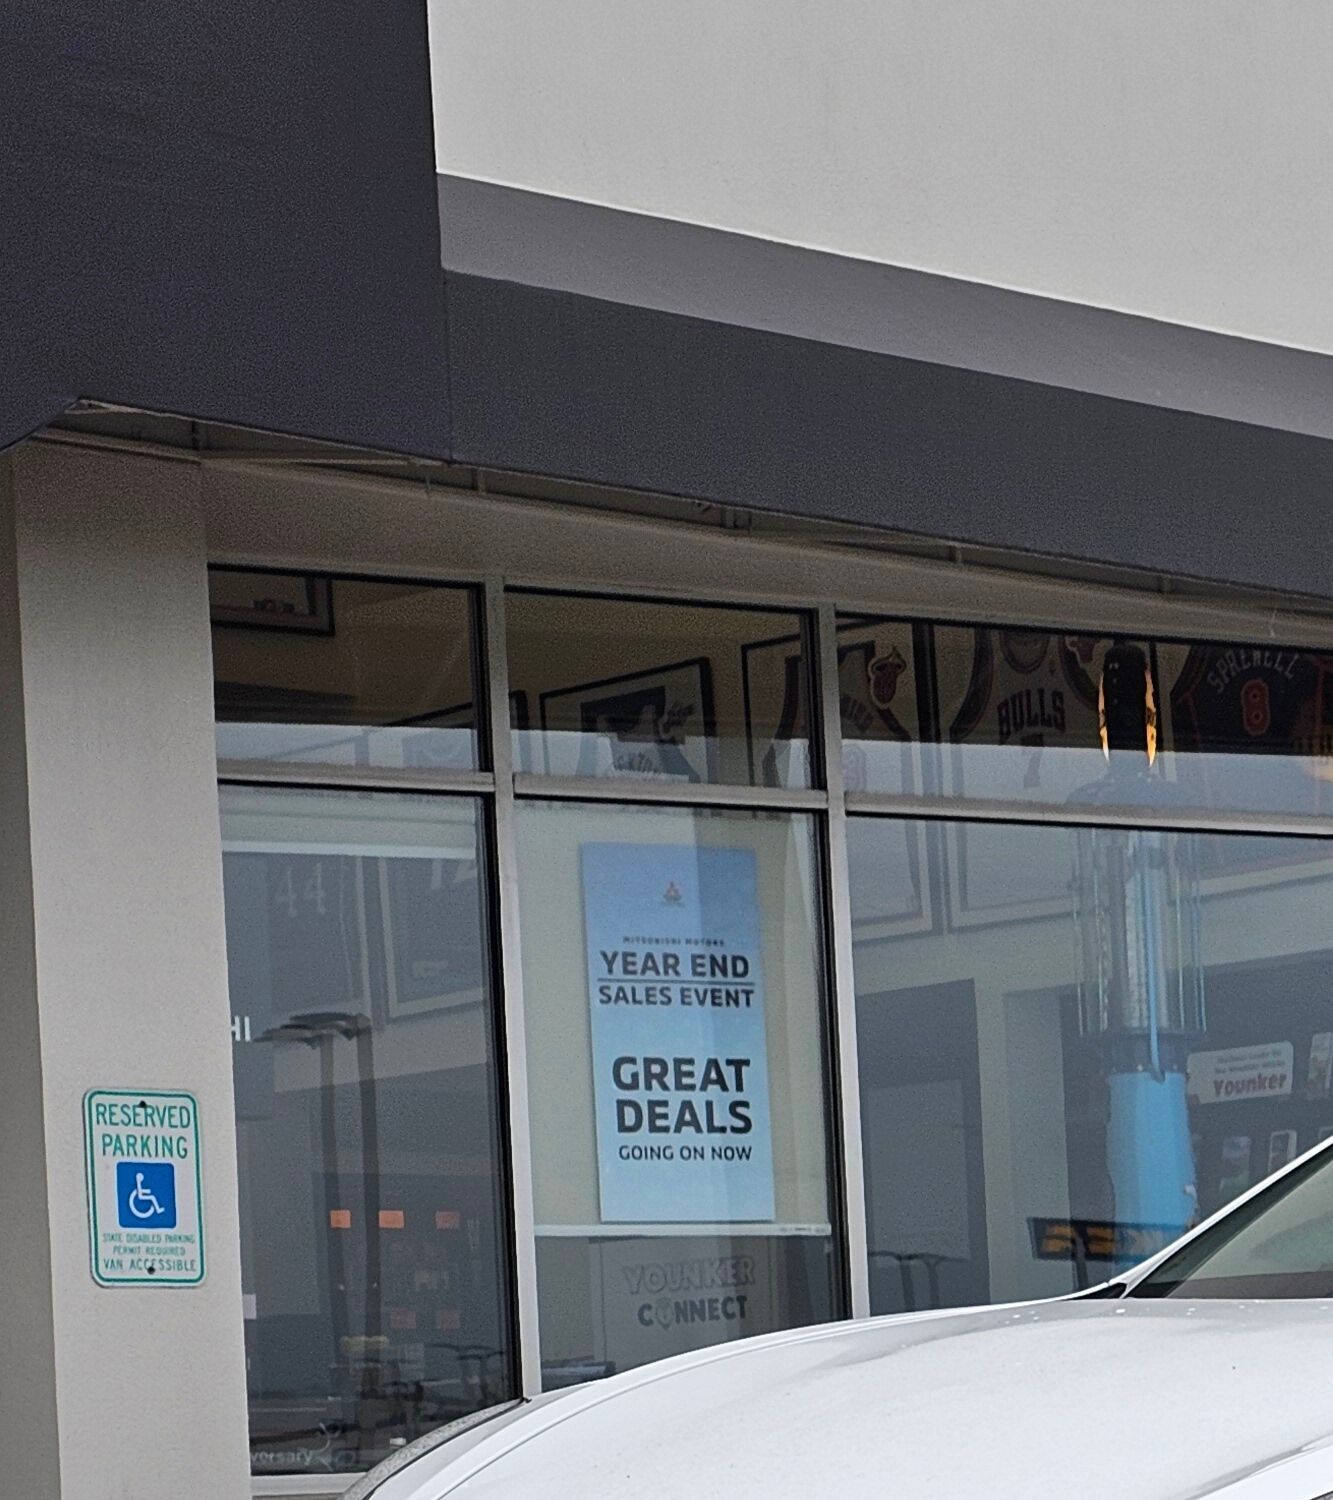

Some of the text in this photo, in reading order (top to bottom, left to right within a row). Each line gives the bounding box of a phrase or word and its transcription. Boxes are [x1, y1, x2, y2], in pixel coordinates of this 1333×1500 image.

[997, 687, 1066, 741] BULLS
[622, 936, 681, 946] MITSUBISHI
[600, 950, 750, 979] YEAR END
[598, 985, 755, 1008] SALES EVENT
[612, 1056, 751, 1093] GREAT
[1212, 1071, 1288, 1098] Younker
[96, 1102, 191, 1129] RESERVED
[616, 1098, 753, 1135] DEALS
[101, 1133, 188, 1159] PARKING
[618, 1145, 752, 1161] GOING ON NOW
[112, 1245, 186, 1257] PERMIT REQUIRED
[103, 1258, 197, 1272] VAN ACCESSIBLE
[622, 1255, 756, 1295] YOUNKER
